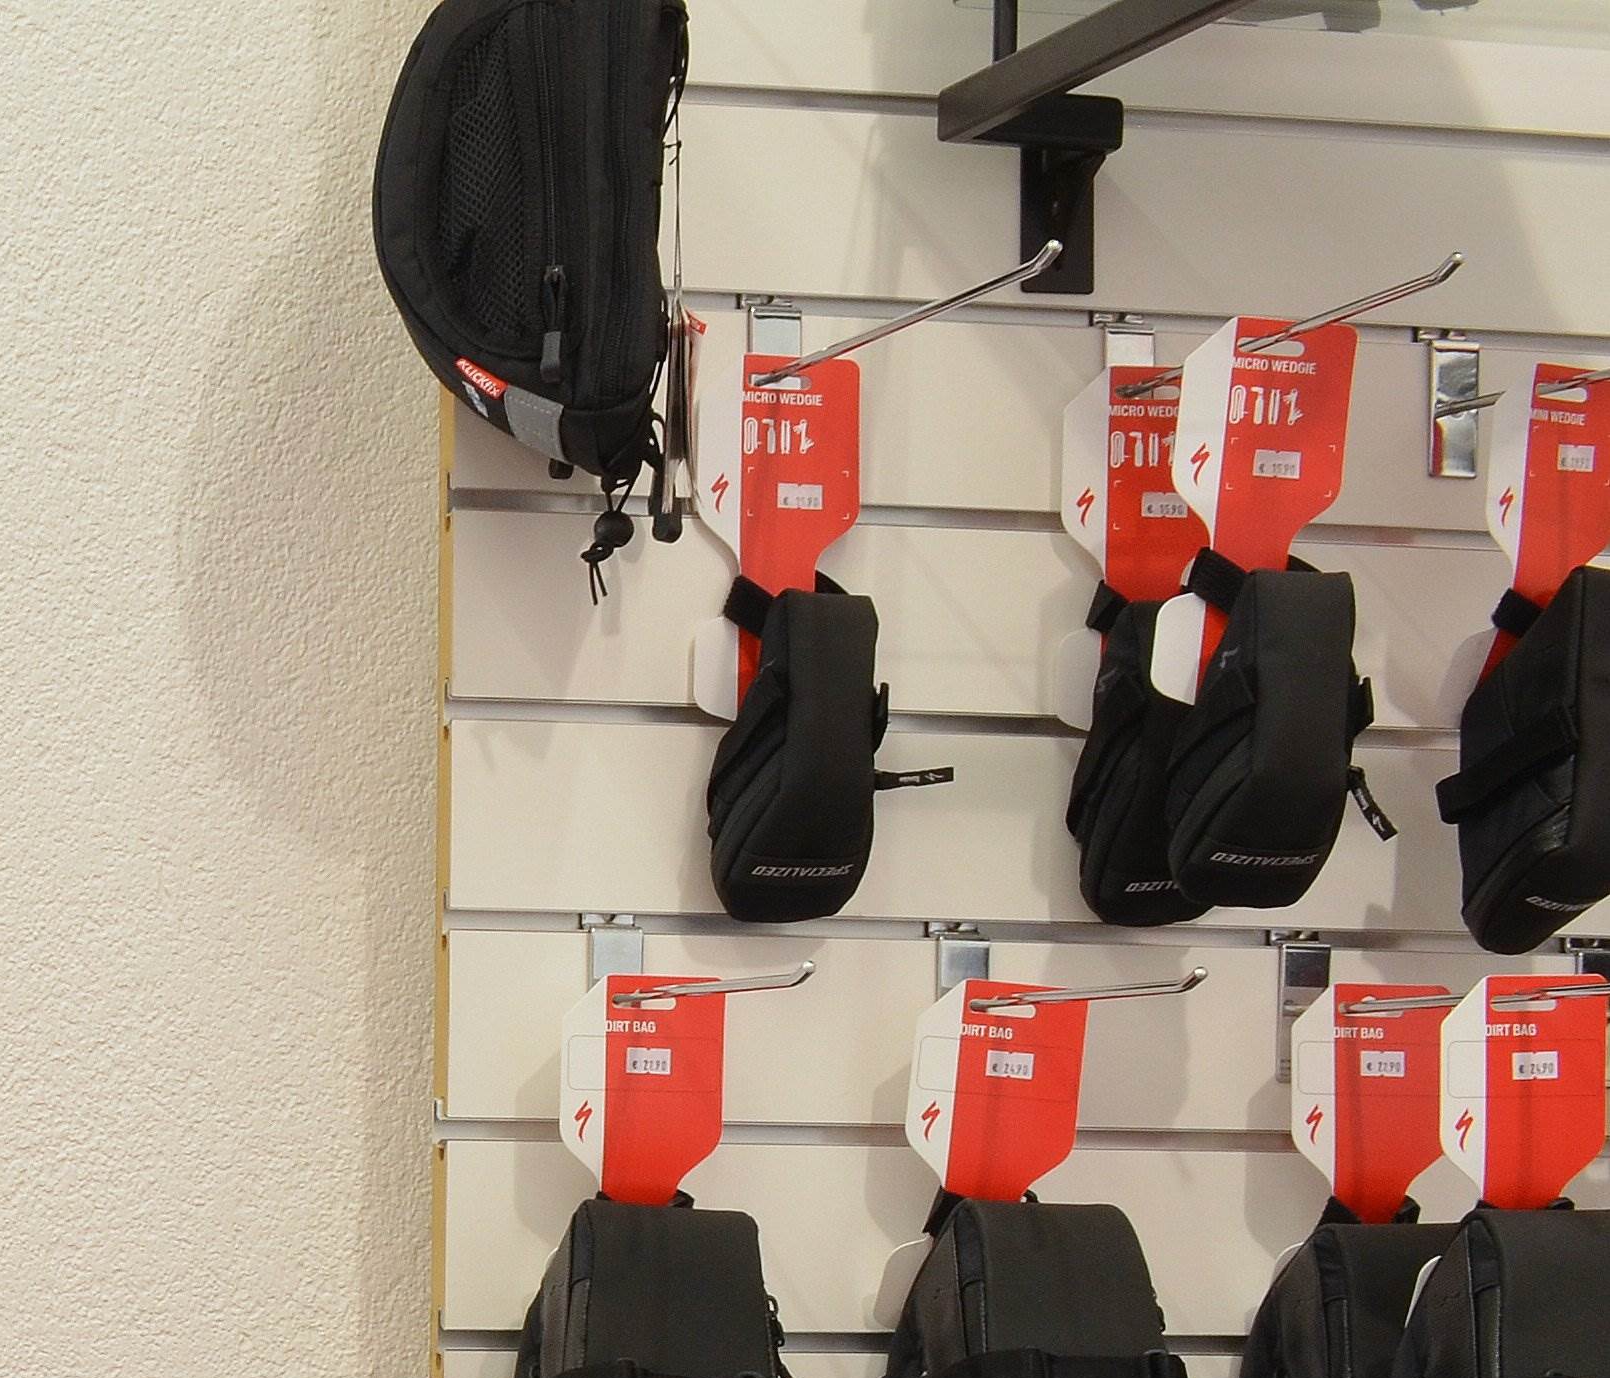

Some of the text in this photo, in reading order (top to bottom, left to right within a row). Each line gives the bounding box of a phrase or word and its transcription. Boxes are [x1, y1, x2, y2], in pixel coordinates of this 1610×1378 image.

[1232, 357, 1317, 375] MICRO WEDGIE
[742, 391, 823, 406] MICRO WEDGIE
[1109, 405, 1144, 417] MICRO
[1209, 851, 1318, 866] SPECIALIZED
[751, 863, 854, 877] SPECIALIZED
[605, 1020, 656, 1033] DIRT BAG
[962, 1023, 1013, 1040] DIRT BAG
[1333, 1026, 1384, 1039] DIRT BAG
[1486, 1023, 1537, 1036] DIRT BAG
